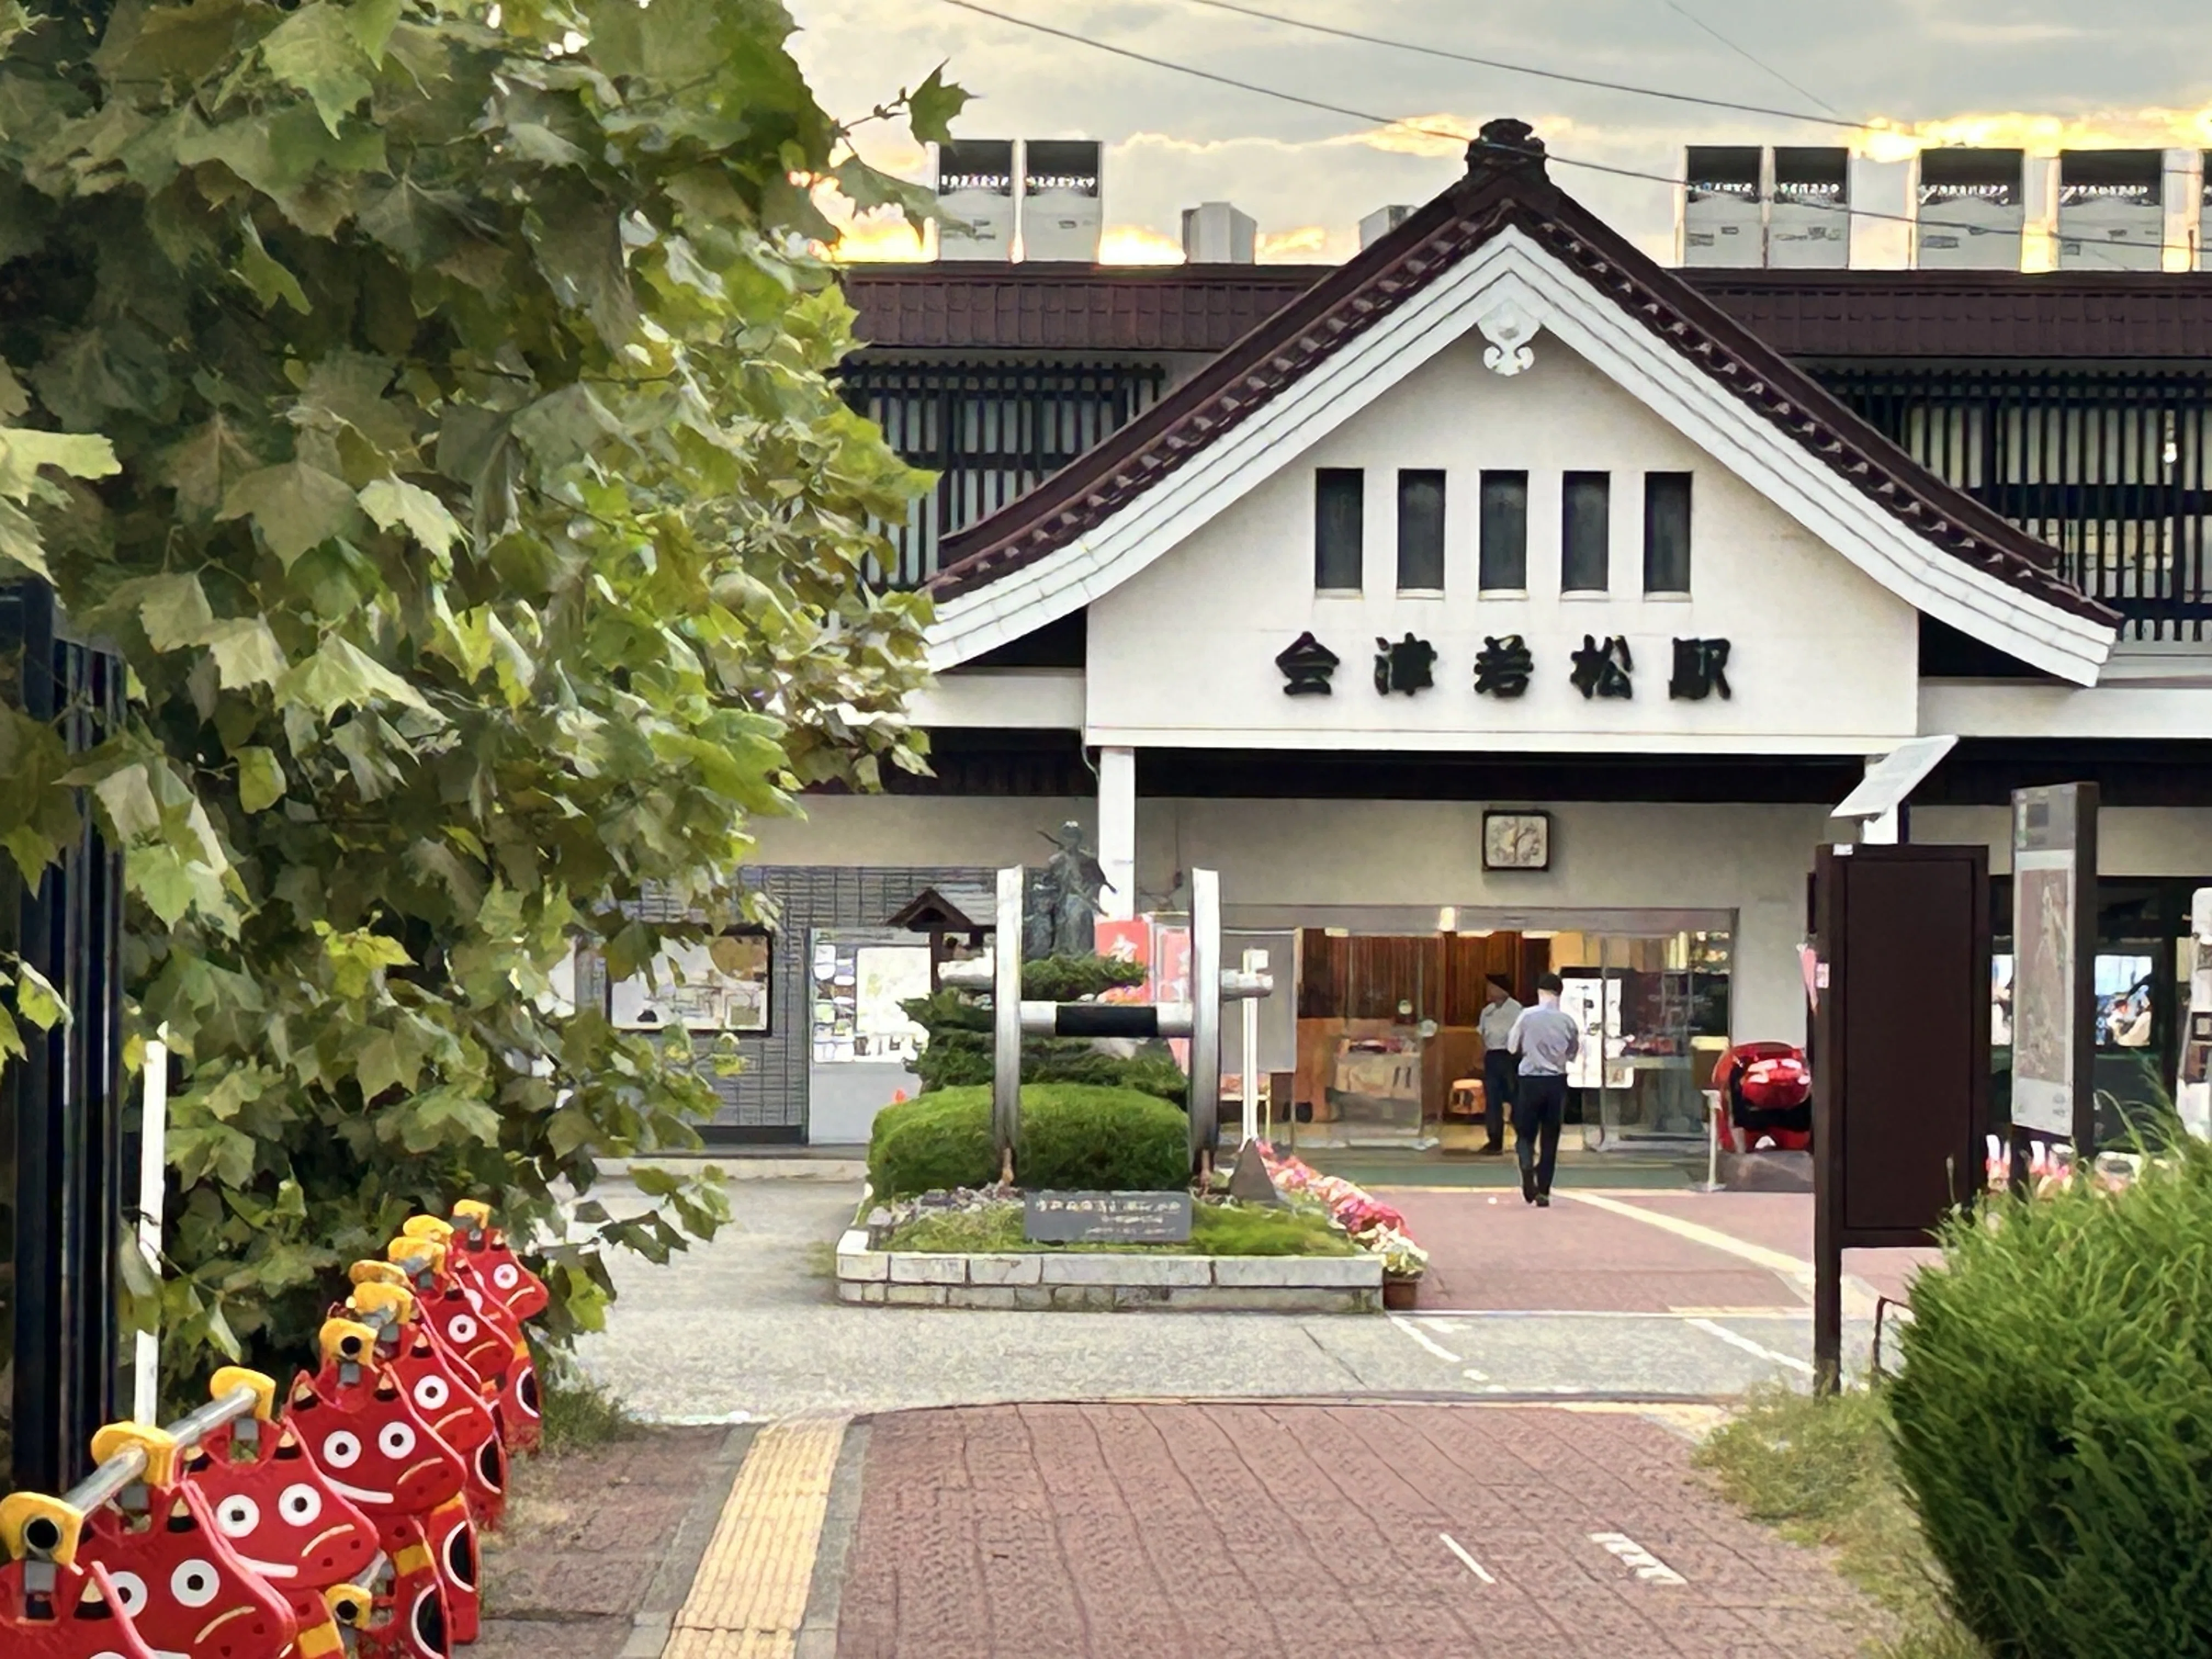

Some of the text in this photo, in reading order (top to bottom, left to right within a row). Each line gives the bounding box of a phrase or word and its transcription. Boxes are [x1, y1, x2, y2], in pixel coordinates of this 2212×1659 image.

[1274, 630, 1733, 701] 会津若松駅
